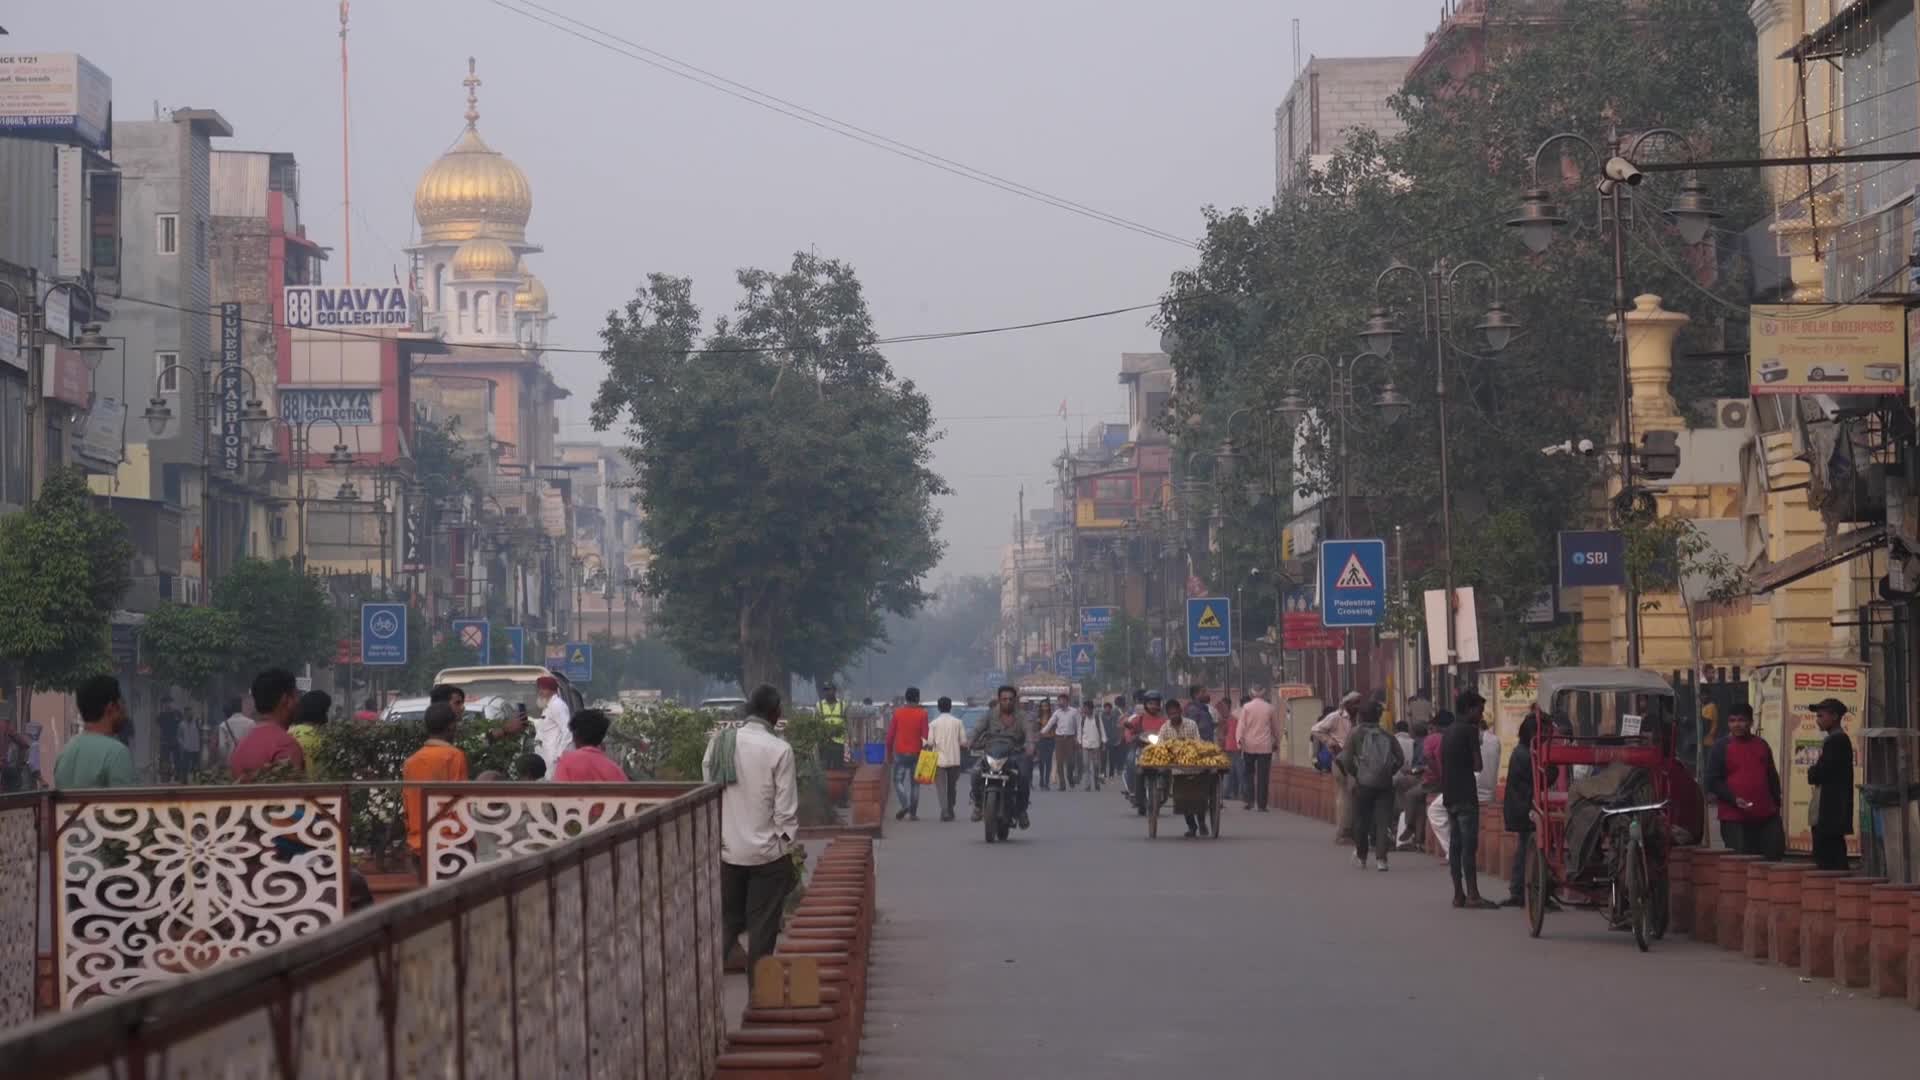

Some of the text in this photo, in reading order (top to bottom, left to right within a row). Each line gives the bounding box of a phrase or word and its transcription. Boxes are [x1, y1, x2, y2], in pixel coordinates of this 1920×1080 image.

[18, 56, 38, 64] 1721
[287, 288, 407, 327] 88 NAVYA
[317, 311, 406, 325] COLLECTION
[304, 391, 371, 408] NAVYA
[305, 409, 371, 419] COLLECTION
[224, 378, 239, 469] FASHIONS
[1586, 552, 1608, 565] SBI
[1334, 599, 1376, 607] Pedestrian
[1337, 608, 1373, 616] Crossing
[1795, 673, 1857, 688] BSES
